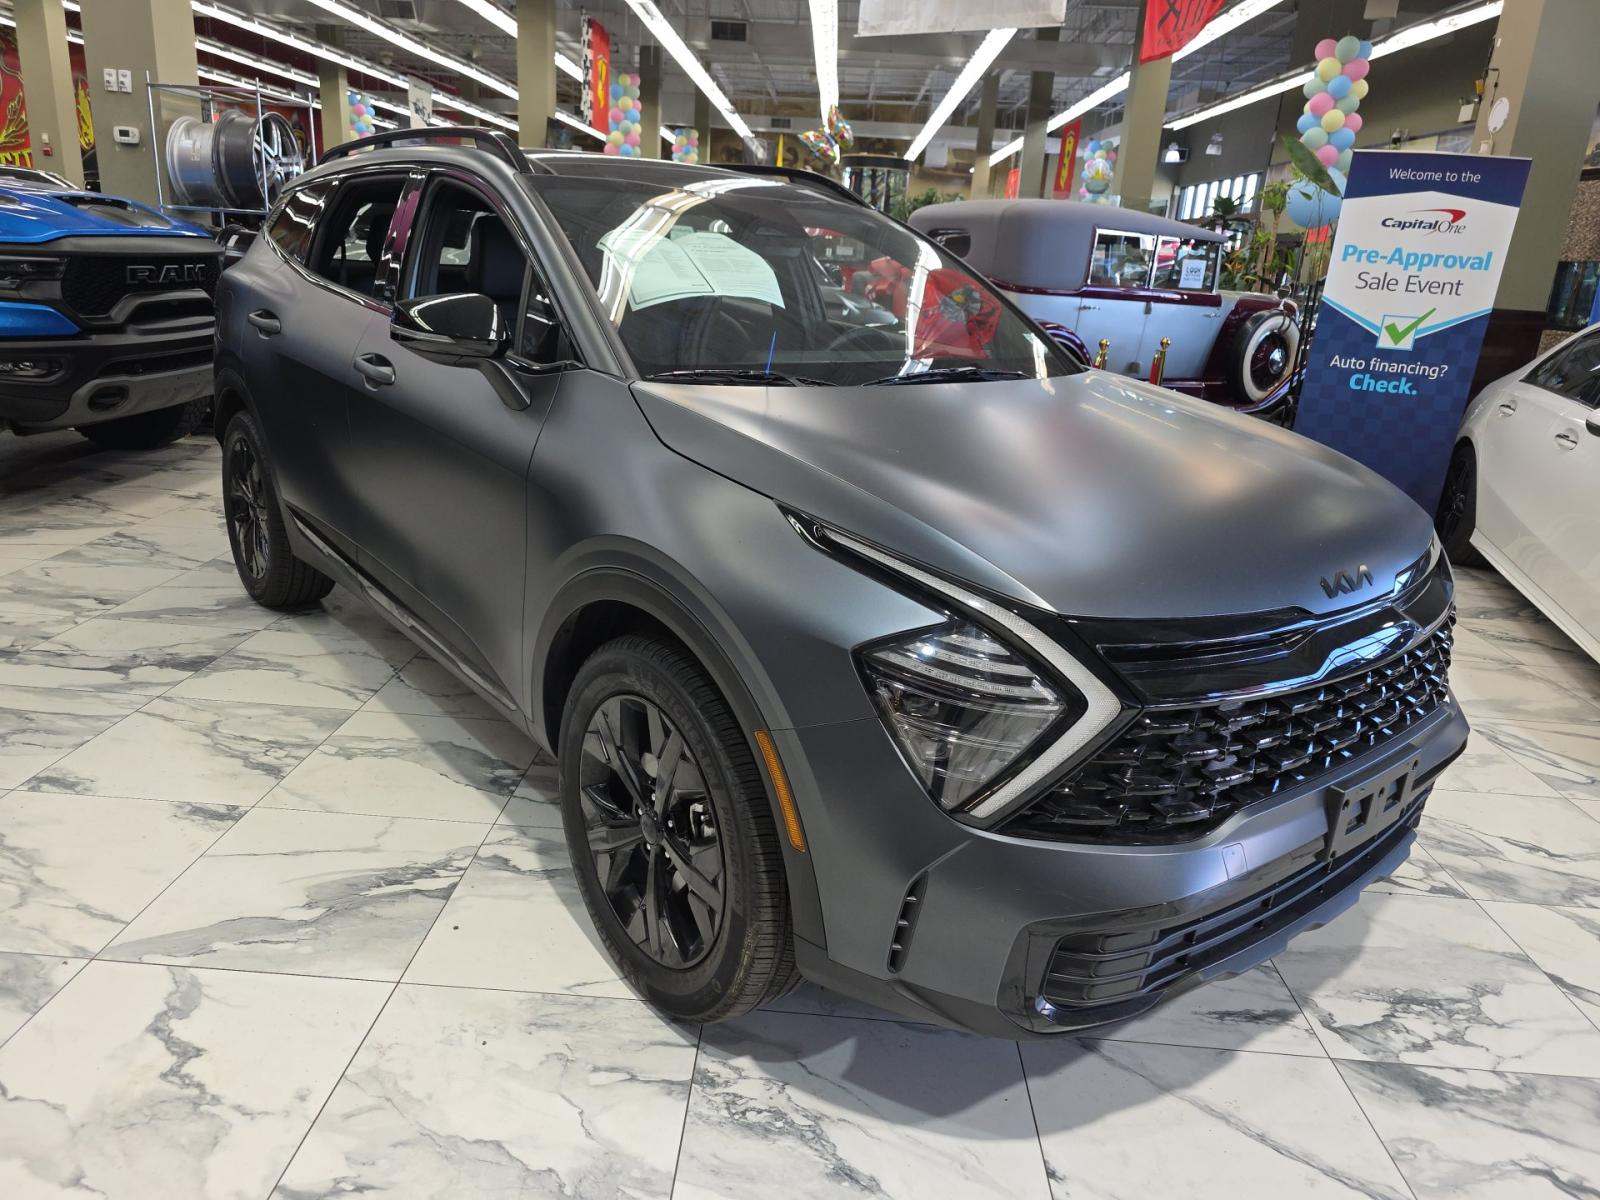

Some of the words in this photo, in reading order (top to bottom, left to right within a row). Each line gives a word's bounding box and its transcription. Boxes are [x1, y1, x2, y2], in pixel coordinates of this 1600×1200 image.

[1389, 168, 1442, 182] Welcome
[1445, 171, 1457, 182] to
[1461, 171, 1481, 183] the
[1341, 244, 1493, 272] Pre-Approval
[126, 264, 207, 284] RAM
[1355, 271, 1399, 292] Sale
[1404, 275, 1464, 296] Event
[1330, 355, 1364, 370] Auto
[1369, 357, 1448, 380] financing?
[1350, 373, 1418, 395] Check.
